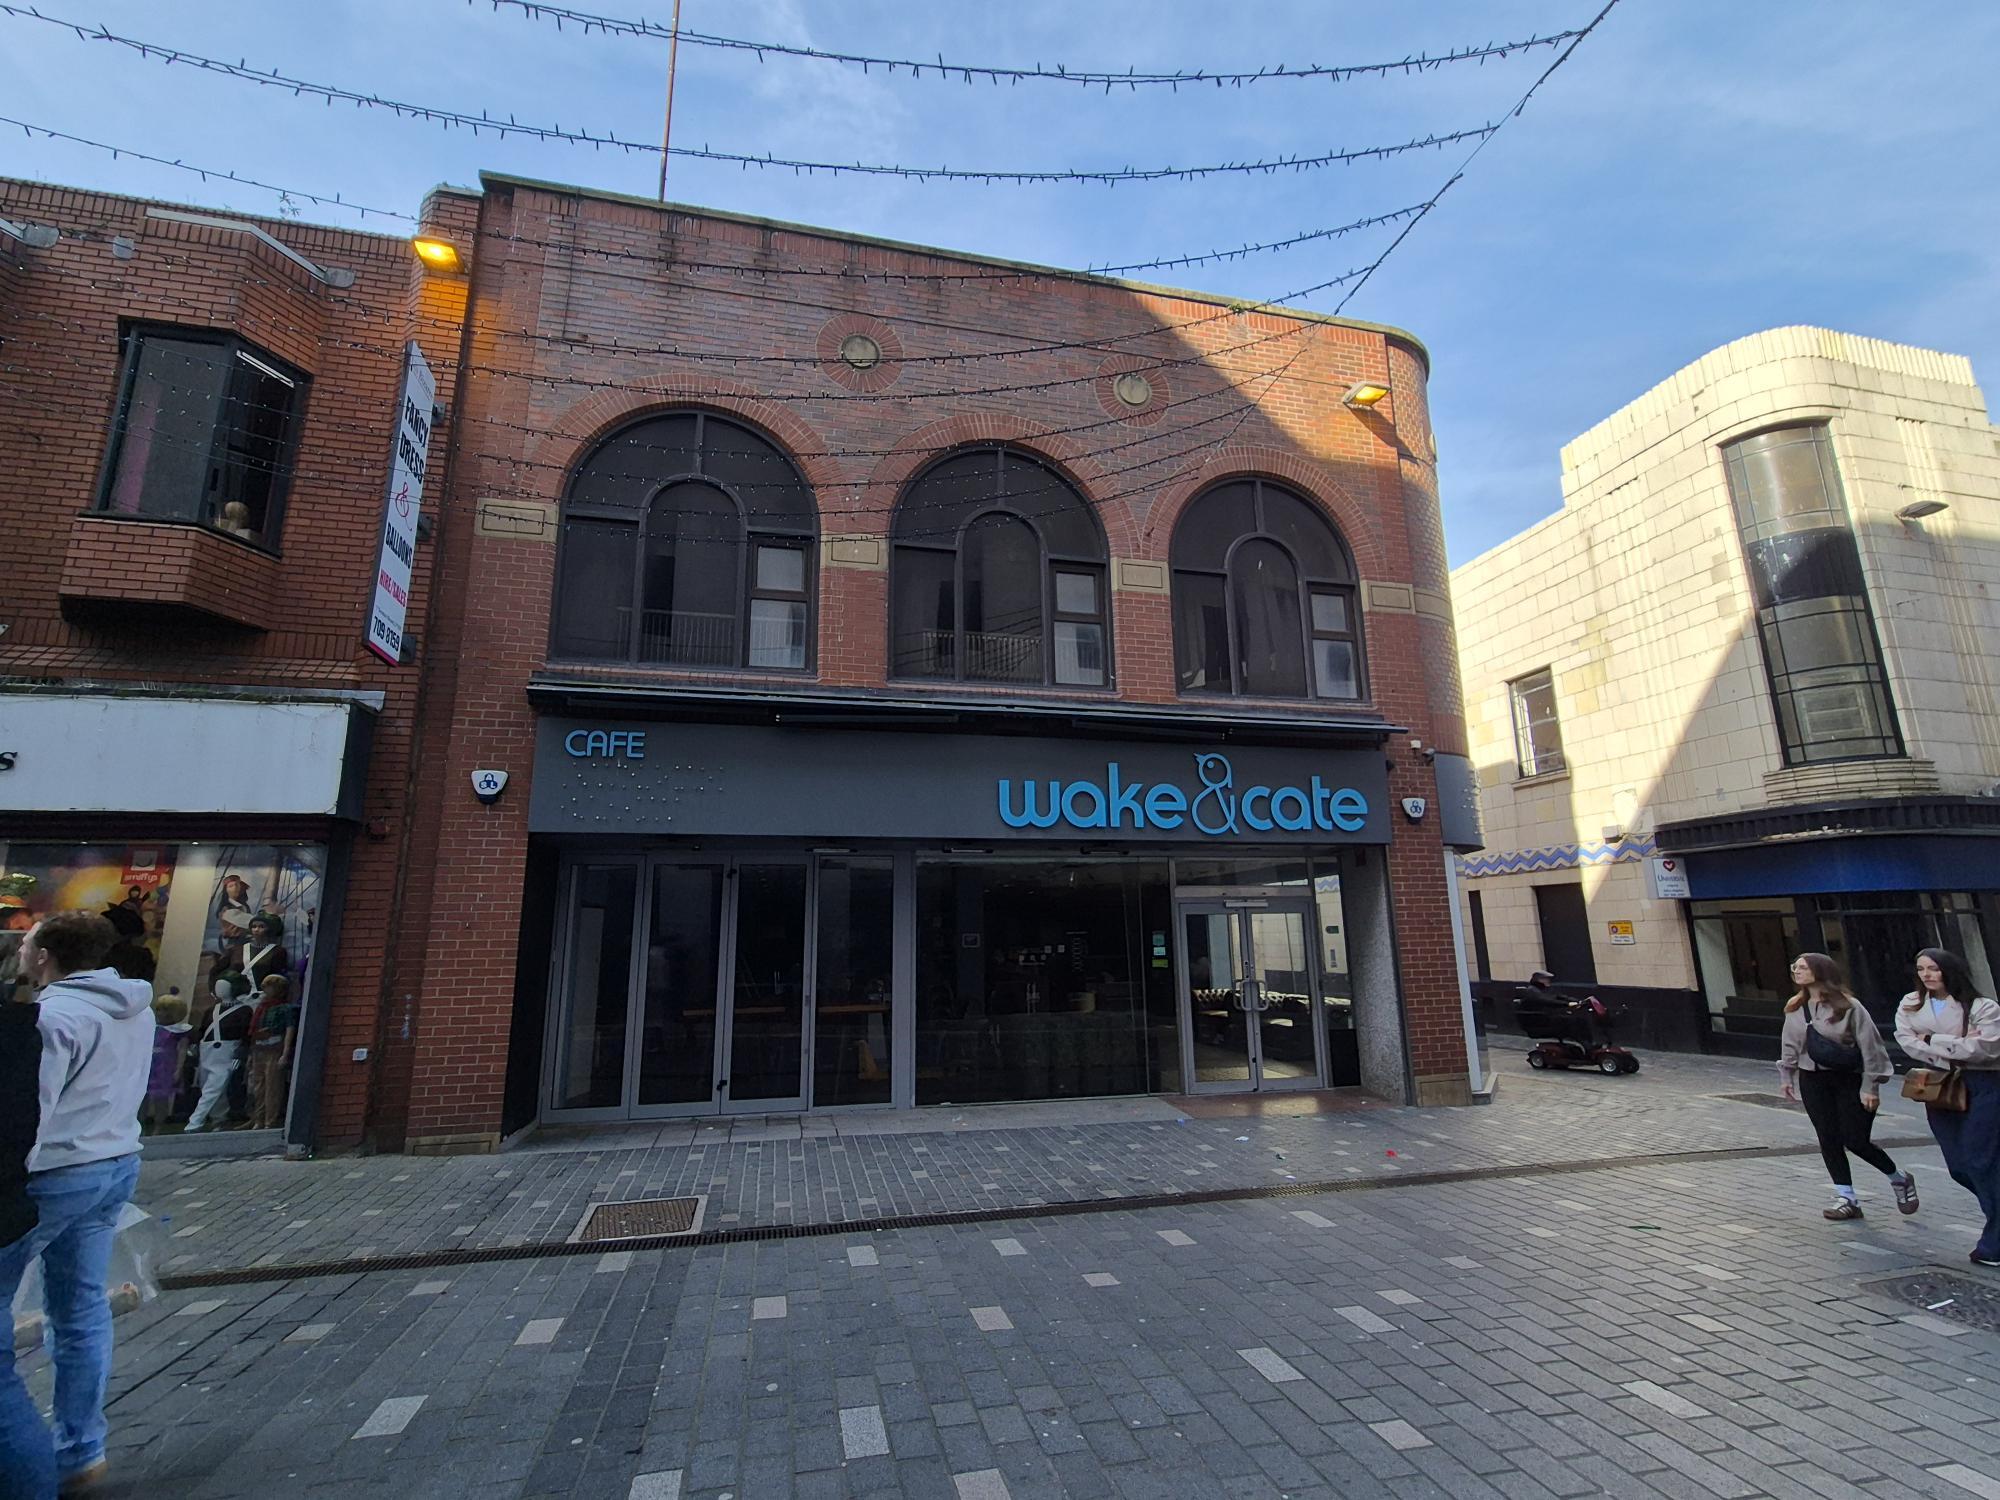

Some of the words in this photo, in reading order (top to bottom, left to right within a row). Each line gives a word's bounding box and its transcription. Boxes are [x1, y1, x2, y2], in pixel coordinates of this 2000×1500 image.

[405, 396, 428, 448] FANCY
[399, 431, 424, 484] DRESS
[396, 481, 412, 531] &
[386, 522, 412, 569] BALLOONS
[373, 615, 385, 640] 709
[386, 628, 400, 652] 8159
[565, 729, 646, 758] CAFE
